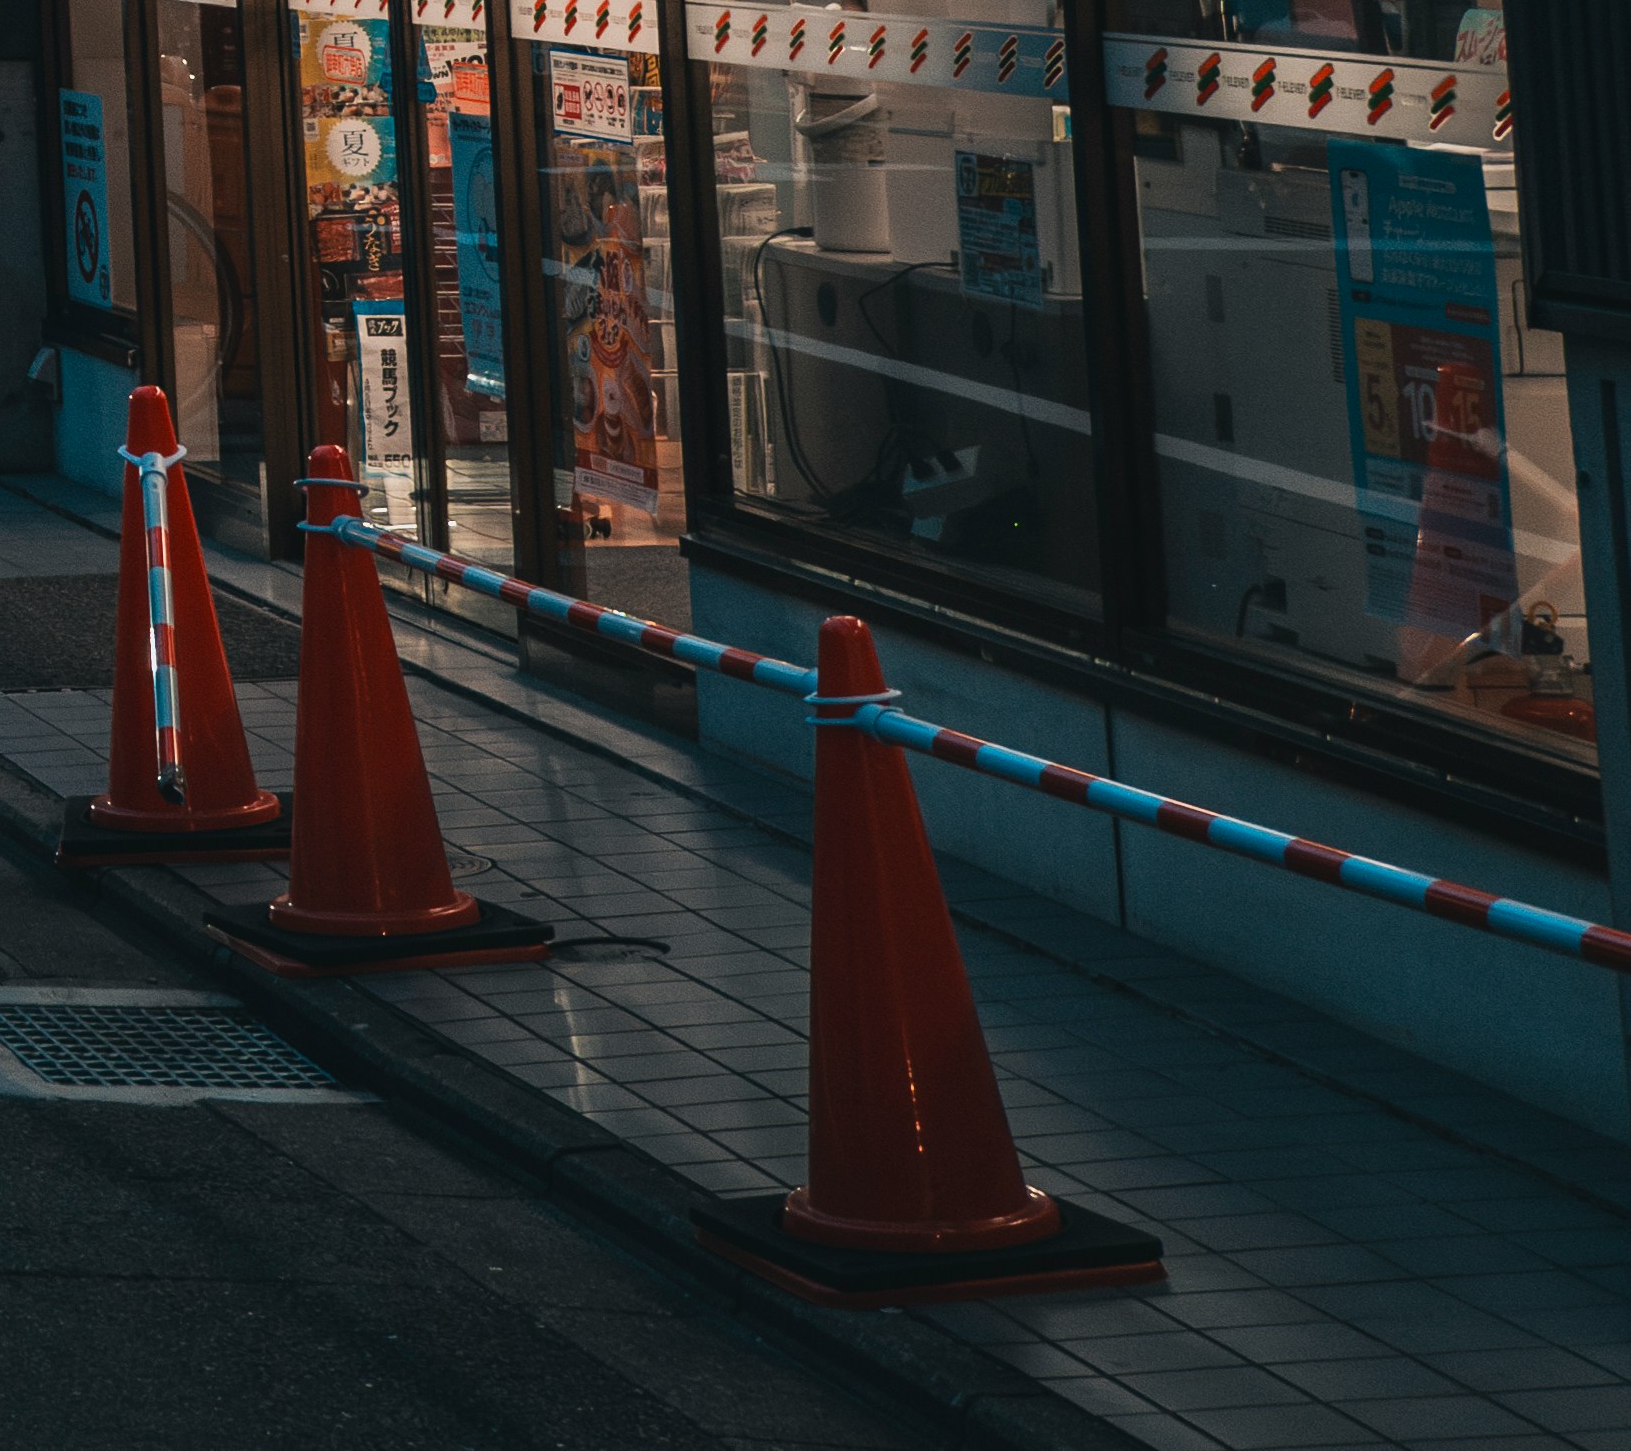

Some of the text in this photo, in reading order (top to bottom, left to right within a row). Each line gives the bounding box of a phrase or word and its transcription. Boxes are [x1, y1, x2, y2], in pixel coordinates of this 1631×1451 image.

[338, 128, 370, 157] 夏
[342, 156, 371, 168] ギフト
[380, 348, 401, 438] 競馬ブック
